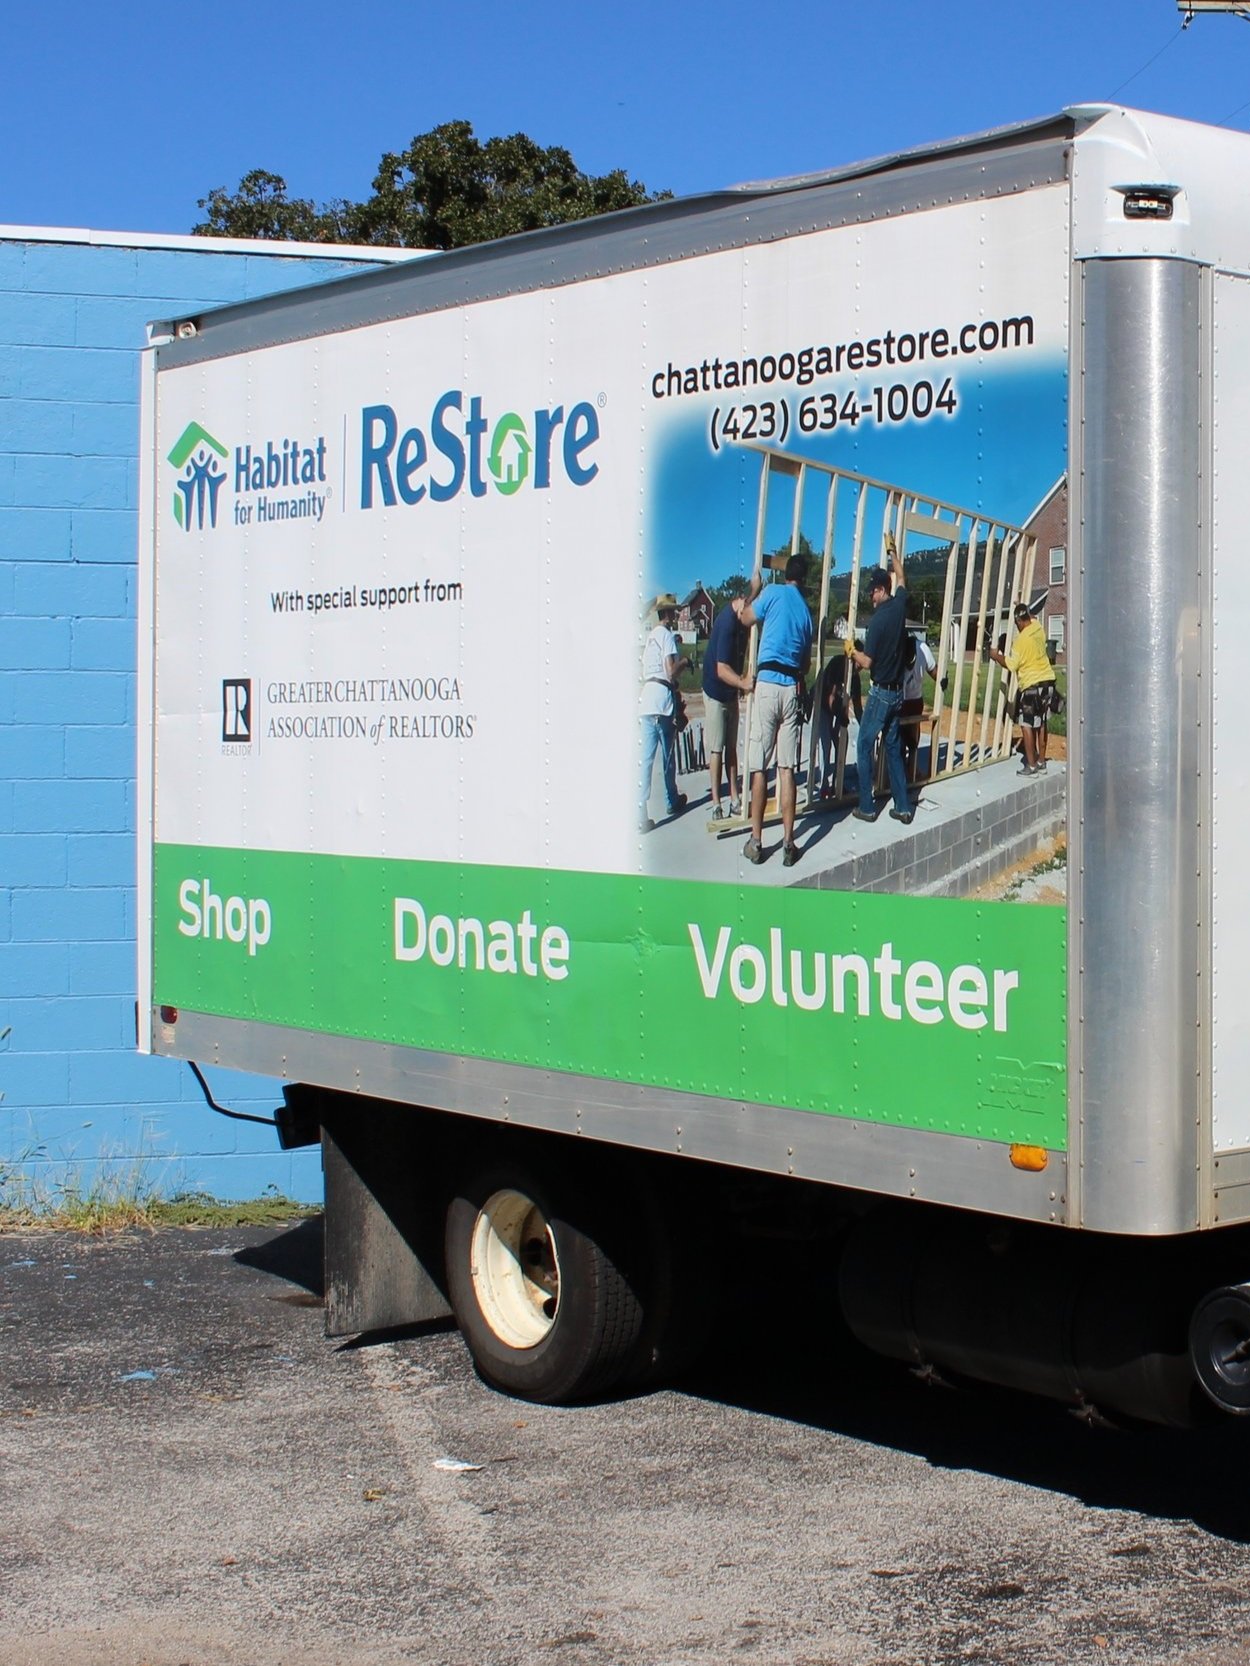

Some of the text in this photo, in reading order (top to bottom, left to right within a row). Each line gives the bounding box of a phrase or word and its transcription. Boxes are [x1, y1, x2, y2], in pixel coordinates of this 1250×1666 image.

[652, 315, 1035, 401] chattanoogarestore.com
[361, 390, 600, 510] ReStore
[710, 378, 958, 450] (423) 634-1004
[234, 437, 327, 493] Habitat
[234, 492, 326, 526] for Humanity
[271, 578, 463, 614] With special support from
[267, 715, 367, 739] ASSOCIATION
[369, 714, 386, 746] of
[178, 879, 272, 956] Shop
[393, 898, 570, 981] Donate
[687, 923, 1019, 1032] Volunteer
